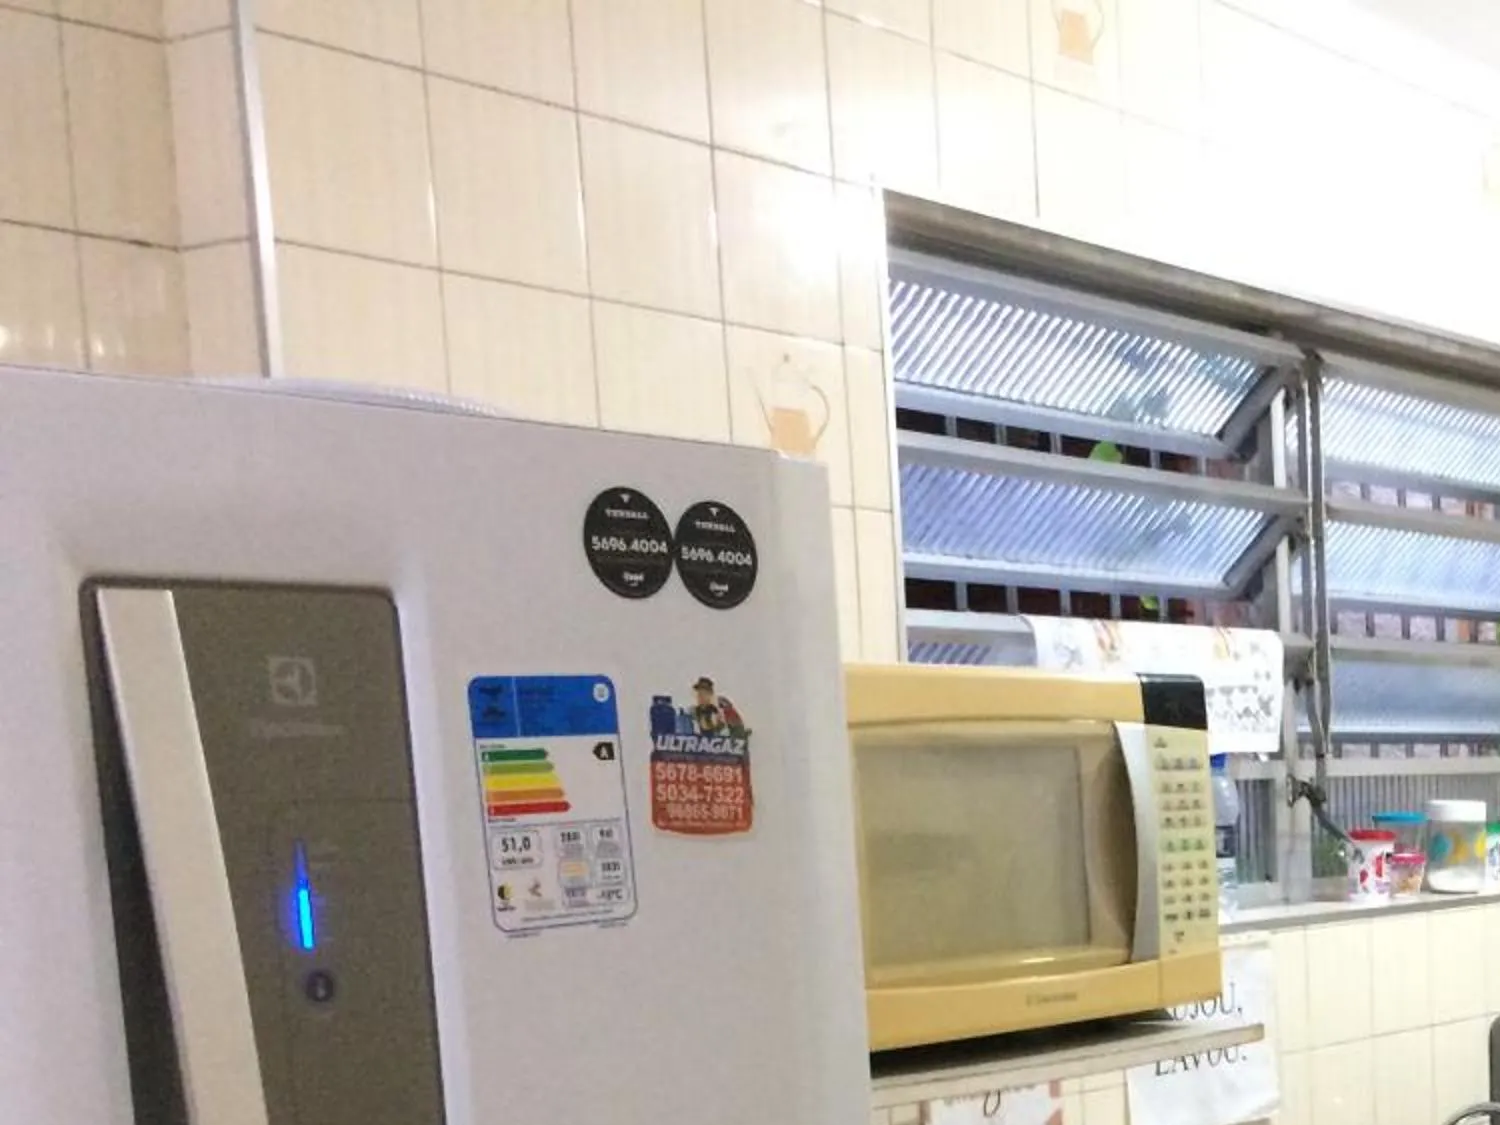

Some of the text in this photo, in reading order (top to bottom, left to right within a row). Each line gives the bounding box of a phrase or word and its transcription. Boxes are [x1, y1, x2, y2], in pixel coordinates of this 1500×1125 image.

[656, 735, 745, 755] ULTRAGAZ
[655, 783, 744, 803] 5034-7322
[498, 836, 532, 854] 51,0
